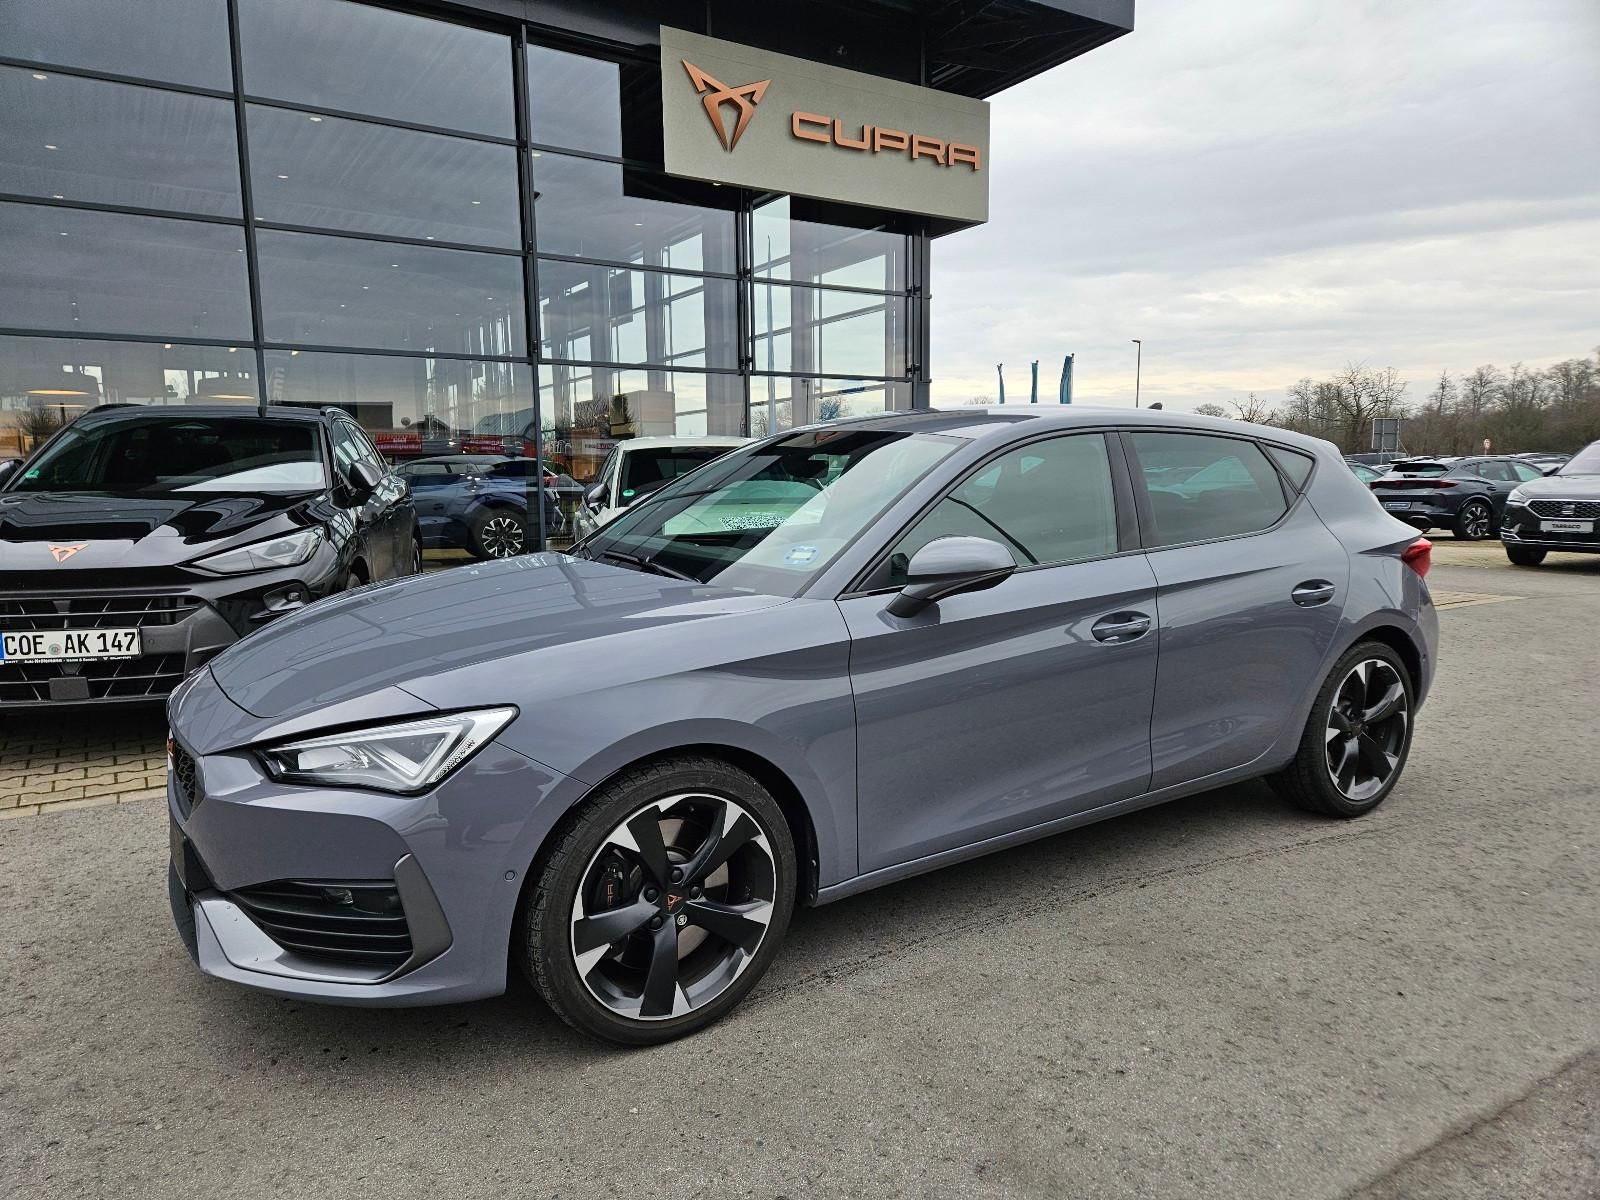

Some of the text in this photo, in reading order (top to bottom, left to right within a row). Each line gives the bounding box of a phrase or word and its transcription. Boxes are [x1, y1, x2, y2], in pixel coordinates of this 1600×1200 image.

[791, 111, 981, 171] CUPRA
[4, 631, 136, 656] COE AK 147
